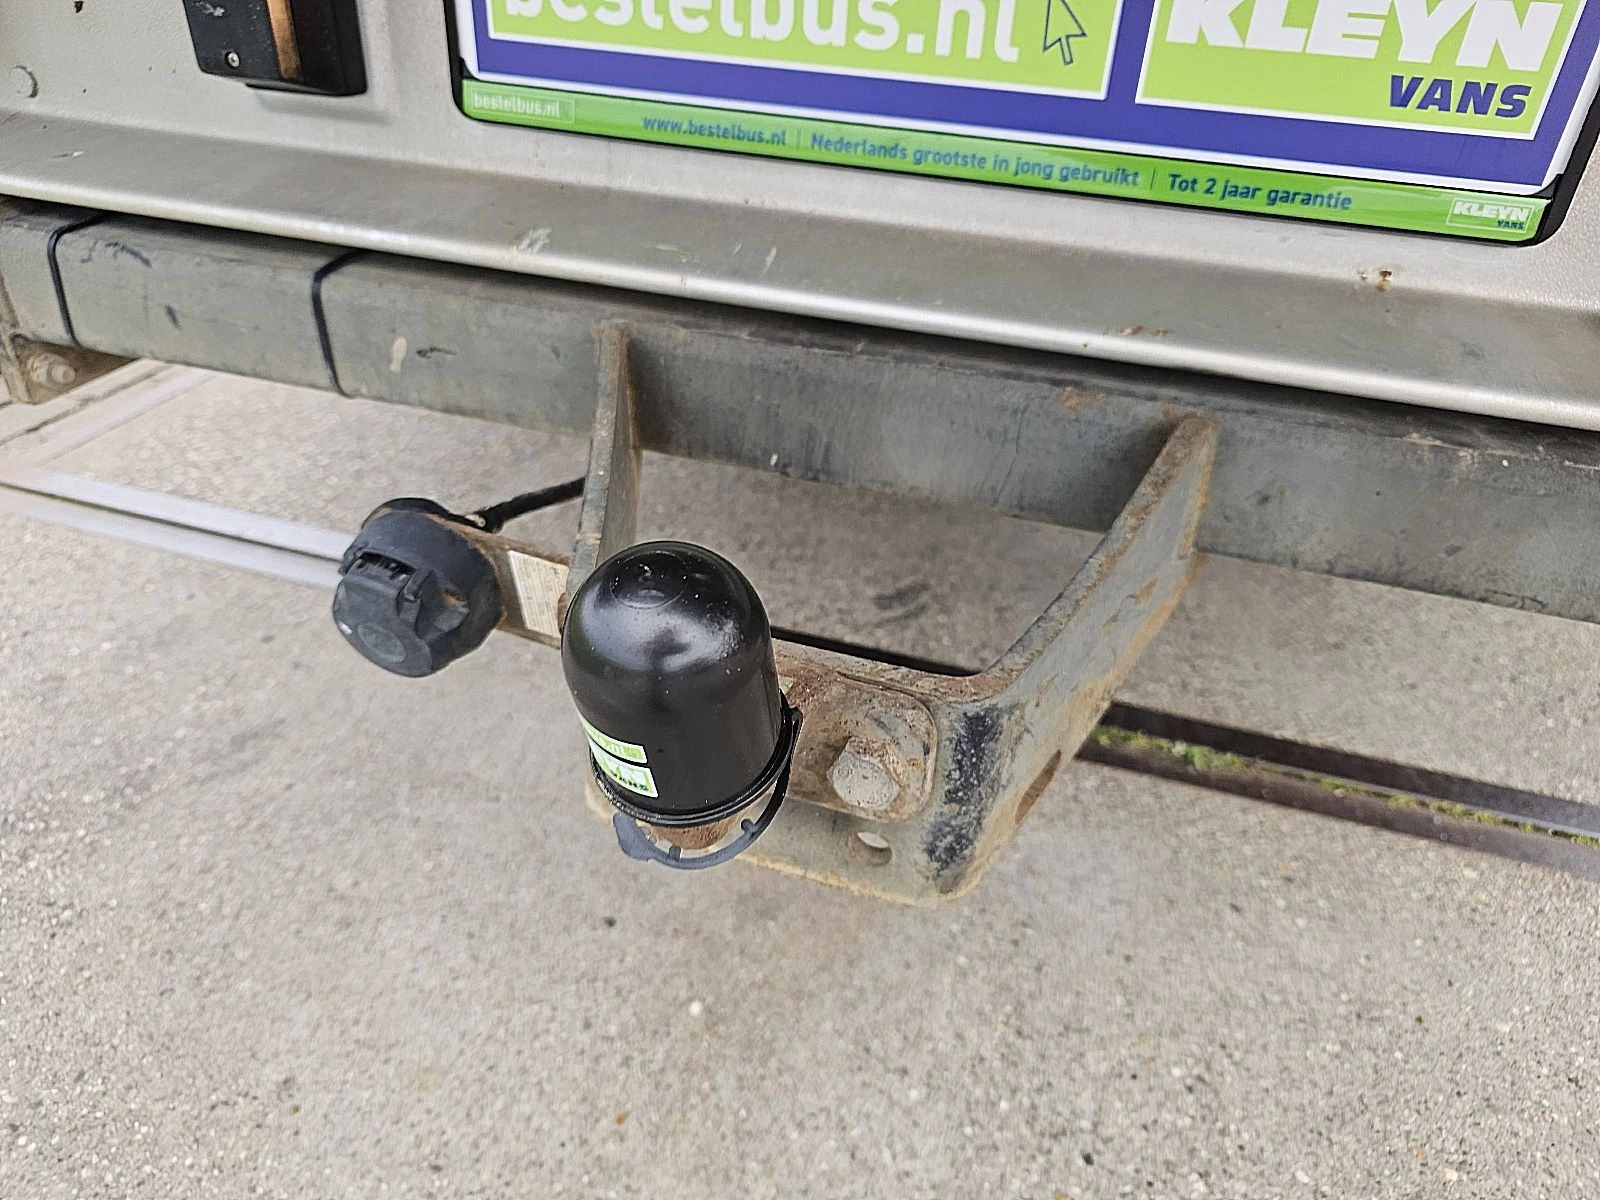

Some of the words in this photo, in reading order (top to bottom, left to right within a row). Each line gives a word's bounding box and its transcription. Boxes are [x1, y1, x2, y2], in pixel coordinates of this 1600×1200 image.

[506, 0, 1020, 63] ebus.nl
[1166, 0, 1564, 72] KLEYN
[472, 91, 560, 118] bestelbus.nl
[1390, 75, 1532, 118] VANS
[643, 116, 787, 146] www.bestelbus.nl
[810, 132, 908, 160] Nederlands
[912, 146, 987, 169] grootste
[992, 154, 1010, 171] in
[1013, 156, 1054, 181] jong
[1058, 162, 1140, 187] gebruikt
[1168, 173, 1198, 193] Tot
[1203, 177, 1217, 195] 2
[1220, 179, 1262, 201] jaar
[1266, 186, 1352, 211] garantie
[1453, 201, 1530, 221] KLEYN
